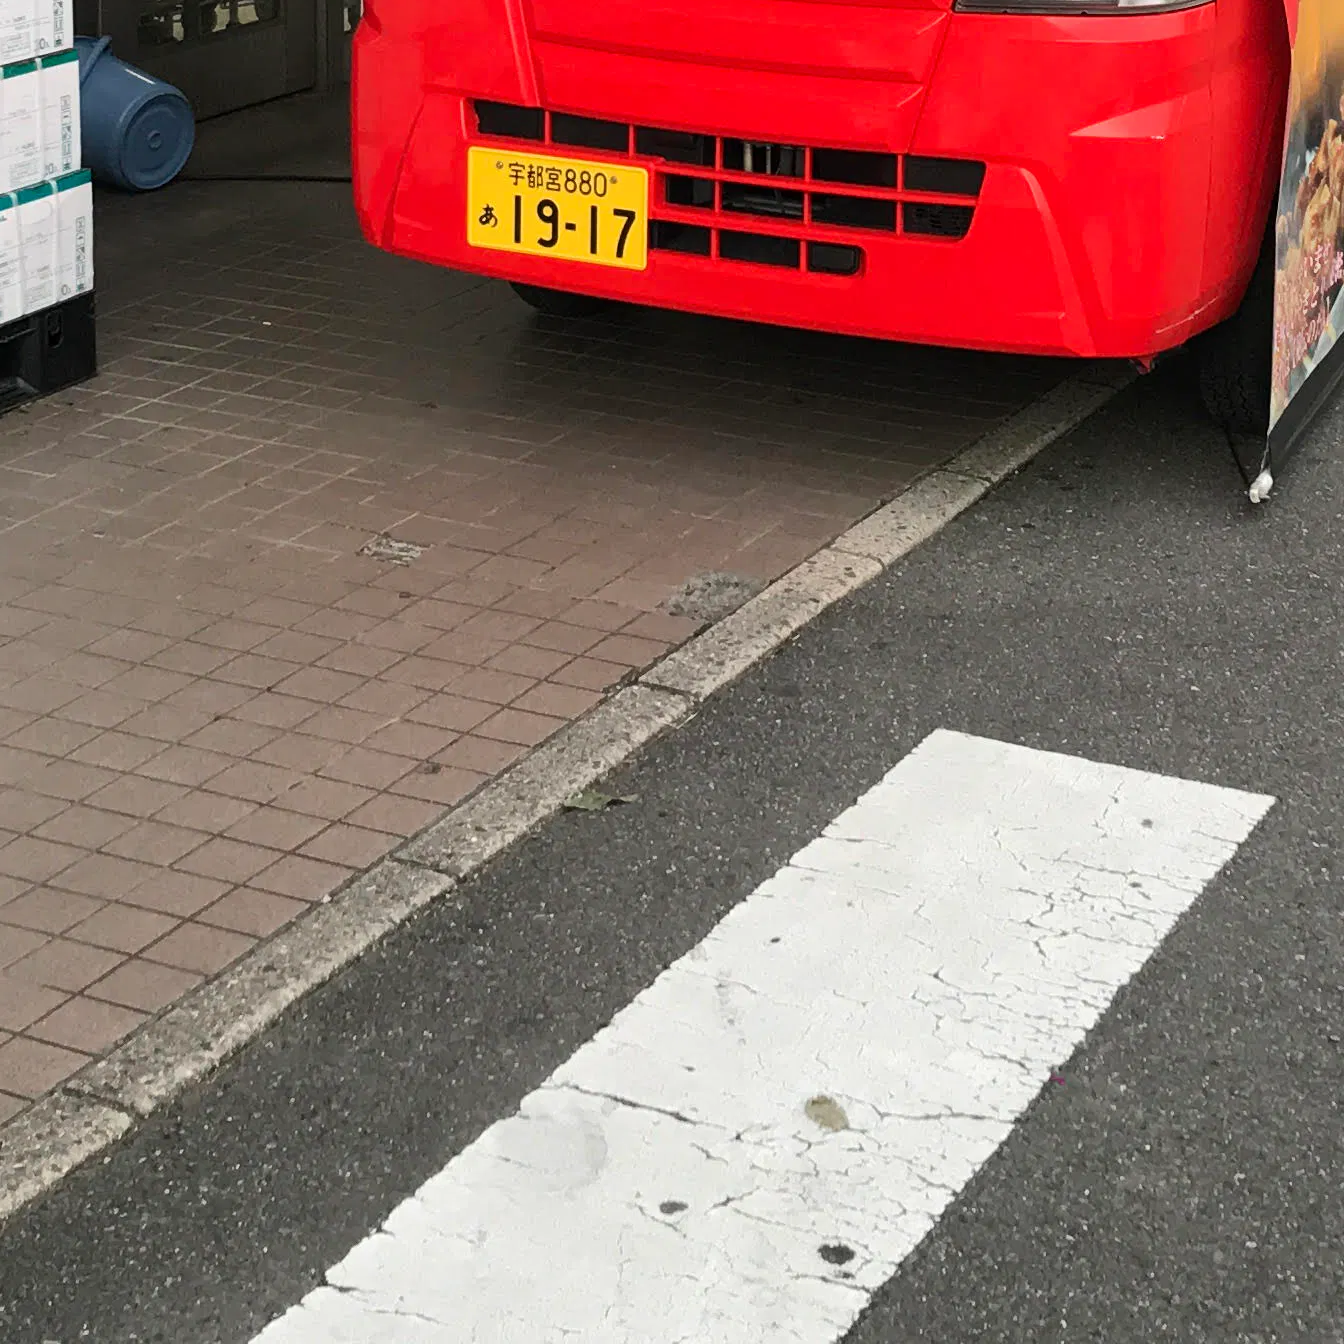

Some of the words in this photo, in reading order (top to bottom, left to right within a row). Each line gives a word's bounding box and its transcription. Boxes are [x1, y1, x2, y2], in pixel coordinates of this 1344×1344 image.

[508, 161, 608, 198] 宇都宮880
[478, 203, 498, 228] あ
[513, 194, 637, 259] 19-17
